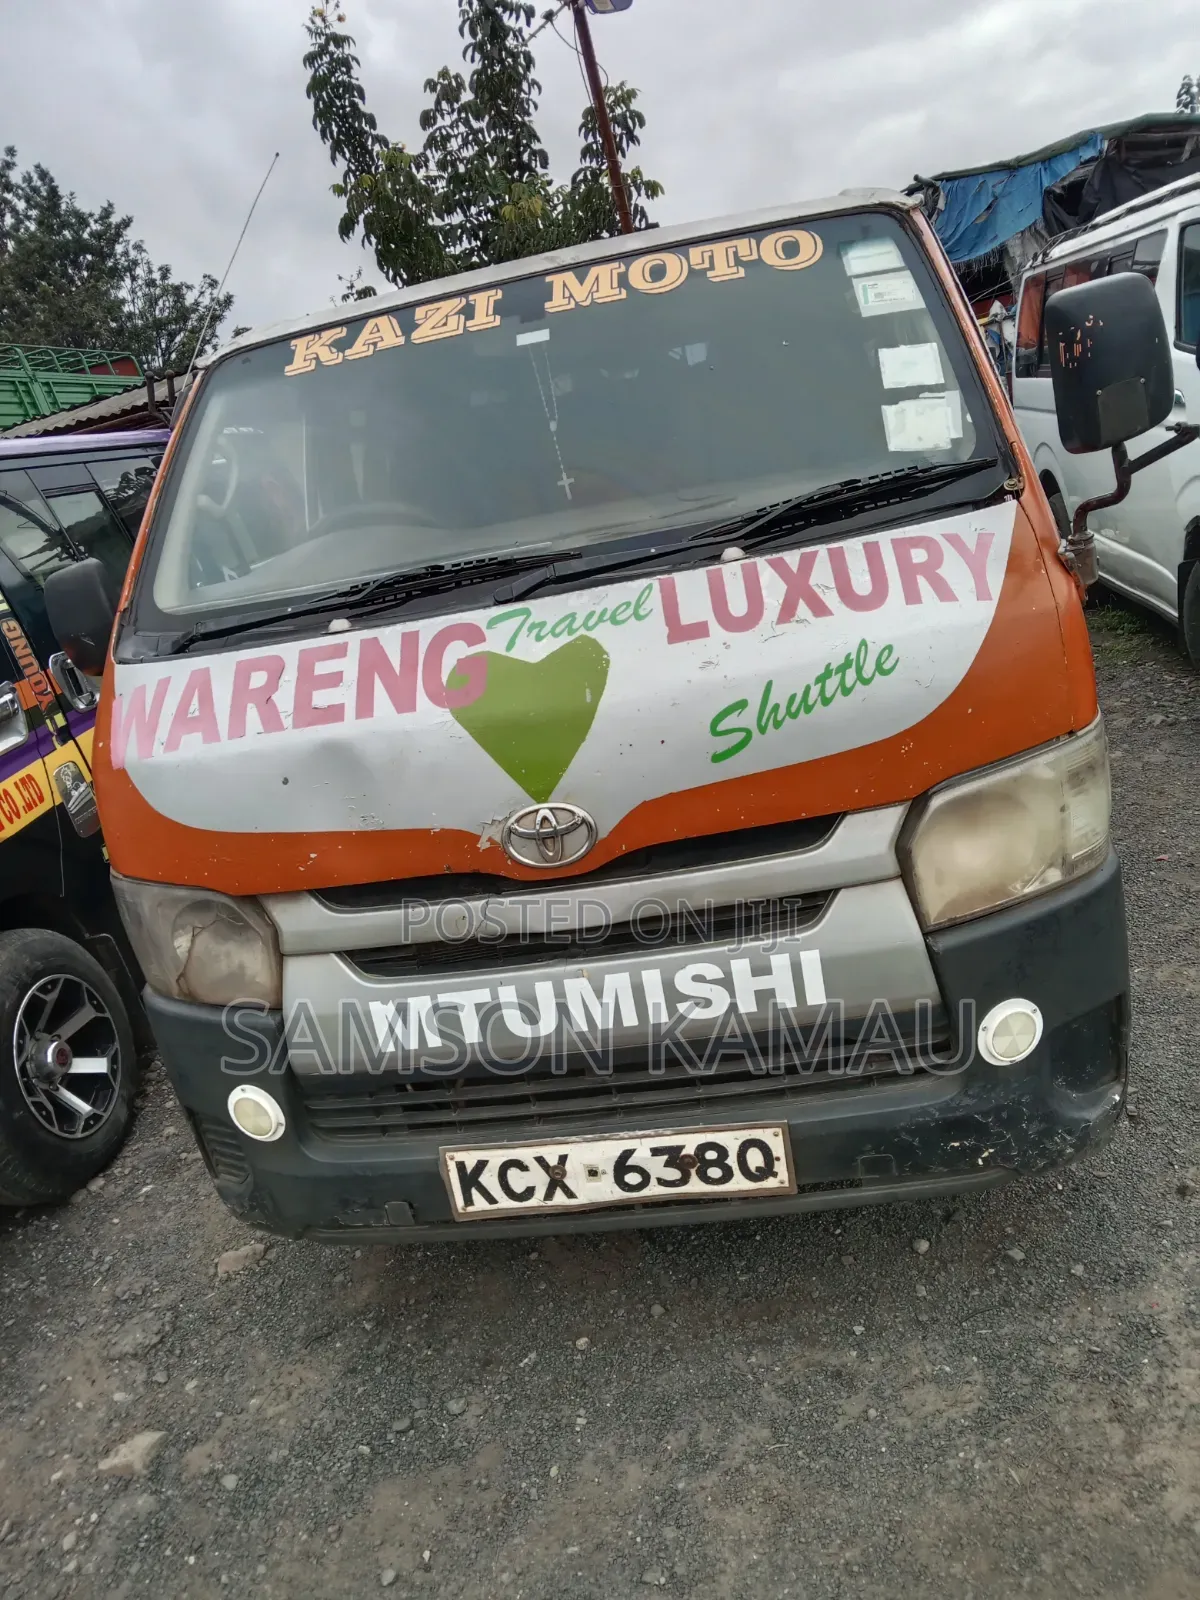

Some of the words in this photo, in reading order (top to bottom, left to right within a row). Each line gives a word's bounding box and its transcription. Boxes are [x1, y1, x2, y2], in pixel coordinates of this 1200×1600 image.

[284, 288, 503, 377] KAZI
[544, 229, 823, 313] MOTO
[111, 621, 488, 769] WARENG
[658, 531, 995, 645] LUXURY
[487, 583, 654, 660] Travel
[709, 638, 899, 764] Shuttle
[367, 949, 827, 1053] MTUMISHI
[455, 1153, 578, 1207] KCX
[613, 1138, 778, 1193] 638Q
